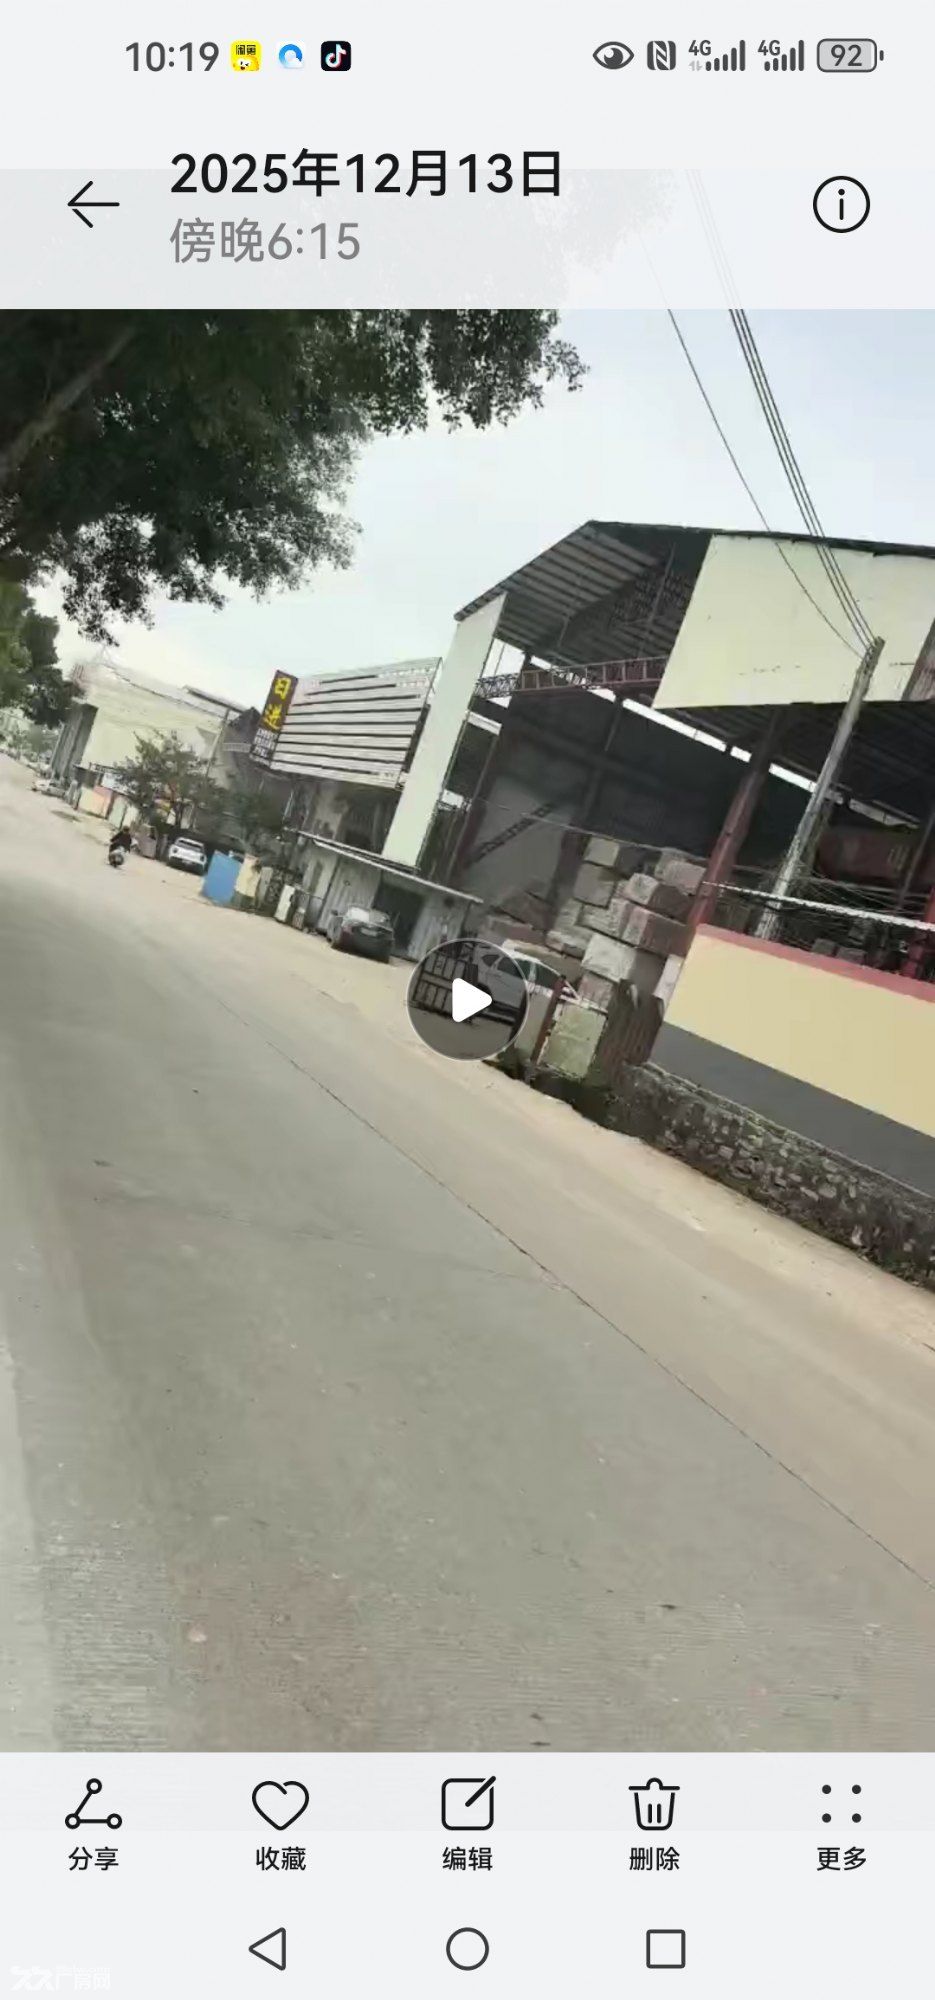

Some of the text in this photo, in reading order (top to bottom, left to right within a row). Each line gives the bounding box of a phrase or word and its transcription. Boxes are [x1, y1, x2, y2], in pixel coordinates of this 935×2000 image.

[125, 41, 220, 73] 10:19
[688, 39, 713, 56] 4G
[757, 39, 781, 56] 4G
[831, 44, 863, 67] 92
[170, 148, 562, 198] 2025年12月13日
[169, 216, 361, 264] 傍晚6:15
[67, 1845, 120, 1872] 分享
[255, 1845, 308, 1872] 收藏
[441, 1845, 494, 1872] 编辑
[628, 1845, 681, 1872] 删除
[816, 1845, 868, 1872] 更多
